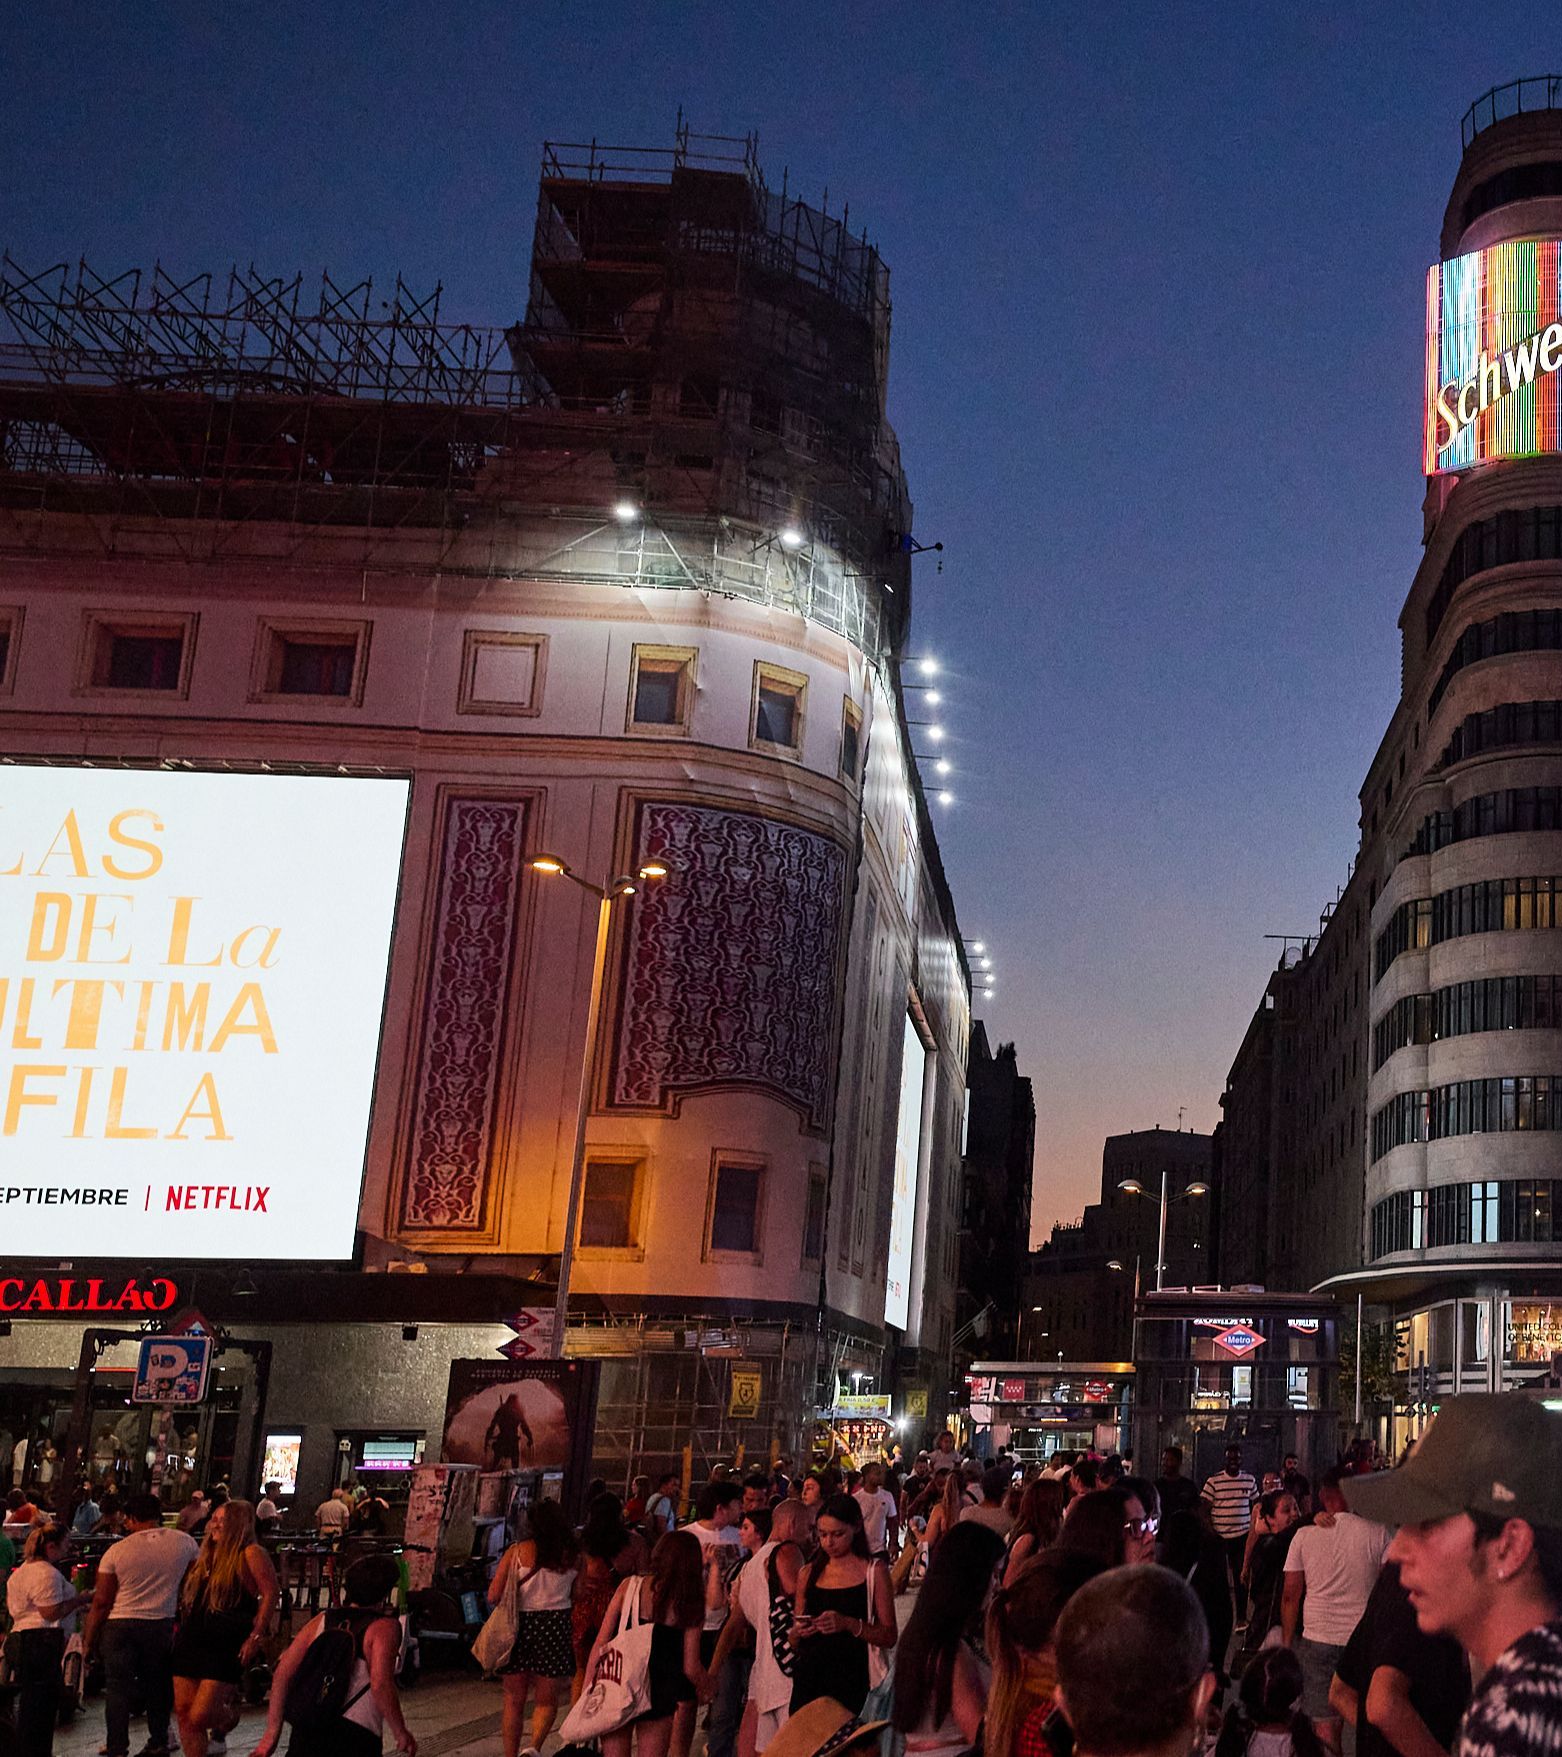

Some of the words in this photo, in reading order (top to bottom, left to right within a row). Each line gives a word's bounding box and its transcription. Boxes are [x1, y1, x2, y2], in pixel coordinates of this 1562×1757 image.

[25, 891, 135, 965] DE
[2, 1064, 234, 1141] FILA
[165, 1185, 271, 1213] NETFLIX
[0, 1278, 179, 1312] CALLAO
[1227, 1333, 1251, 1345] Metro
[1507, 1322, 1541, 1331] UNITED
[1507, 1333, 1519, 1342] OF
